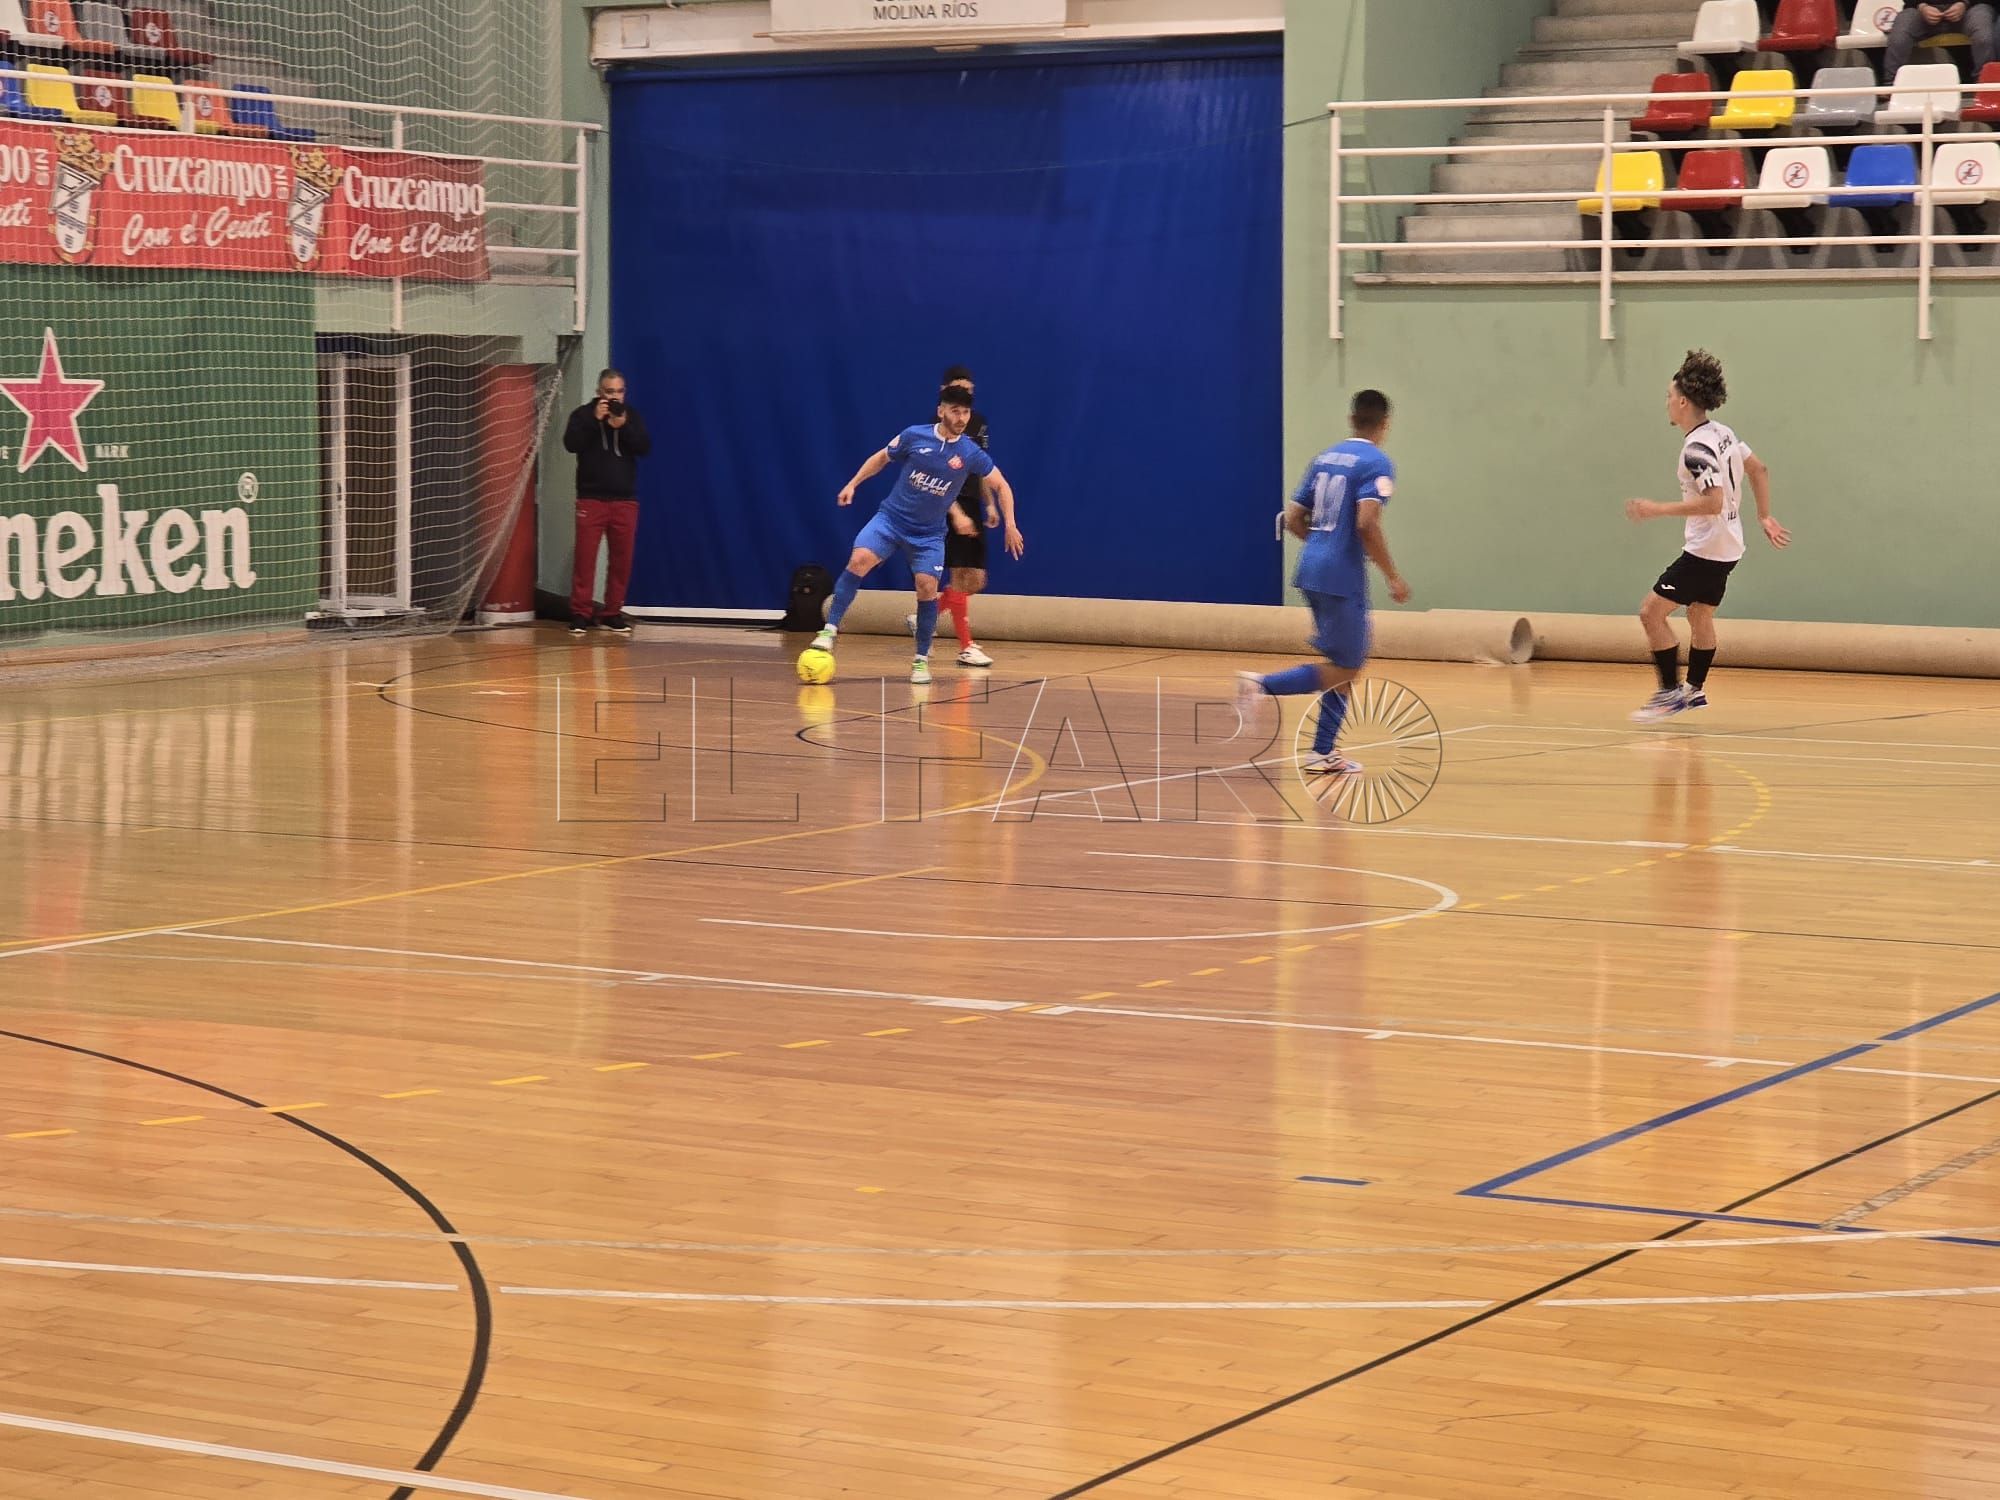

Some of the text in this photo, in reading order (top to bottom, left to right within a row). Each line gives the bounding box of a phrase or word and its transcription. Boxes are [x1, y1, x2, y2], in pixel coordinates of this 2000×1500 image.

[873, 0, 979, 20] MOLINA RÍOS
[113, 144, 272, 206] Cruzcampo
[343, 165, 486, 222] Cruzcampo
[122, 213, 172, 256] Con
[350, 223, 393, 260] Con
[908, 469, 953, 493] MELILLA
[0, 483, 257, 600] neken
